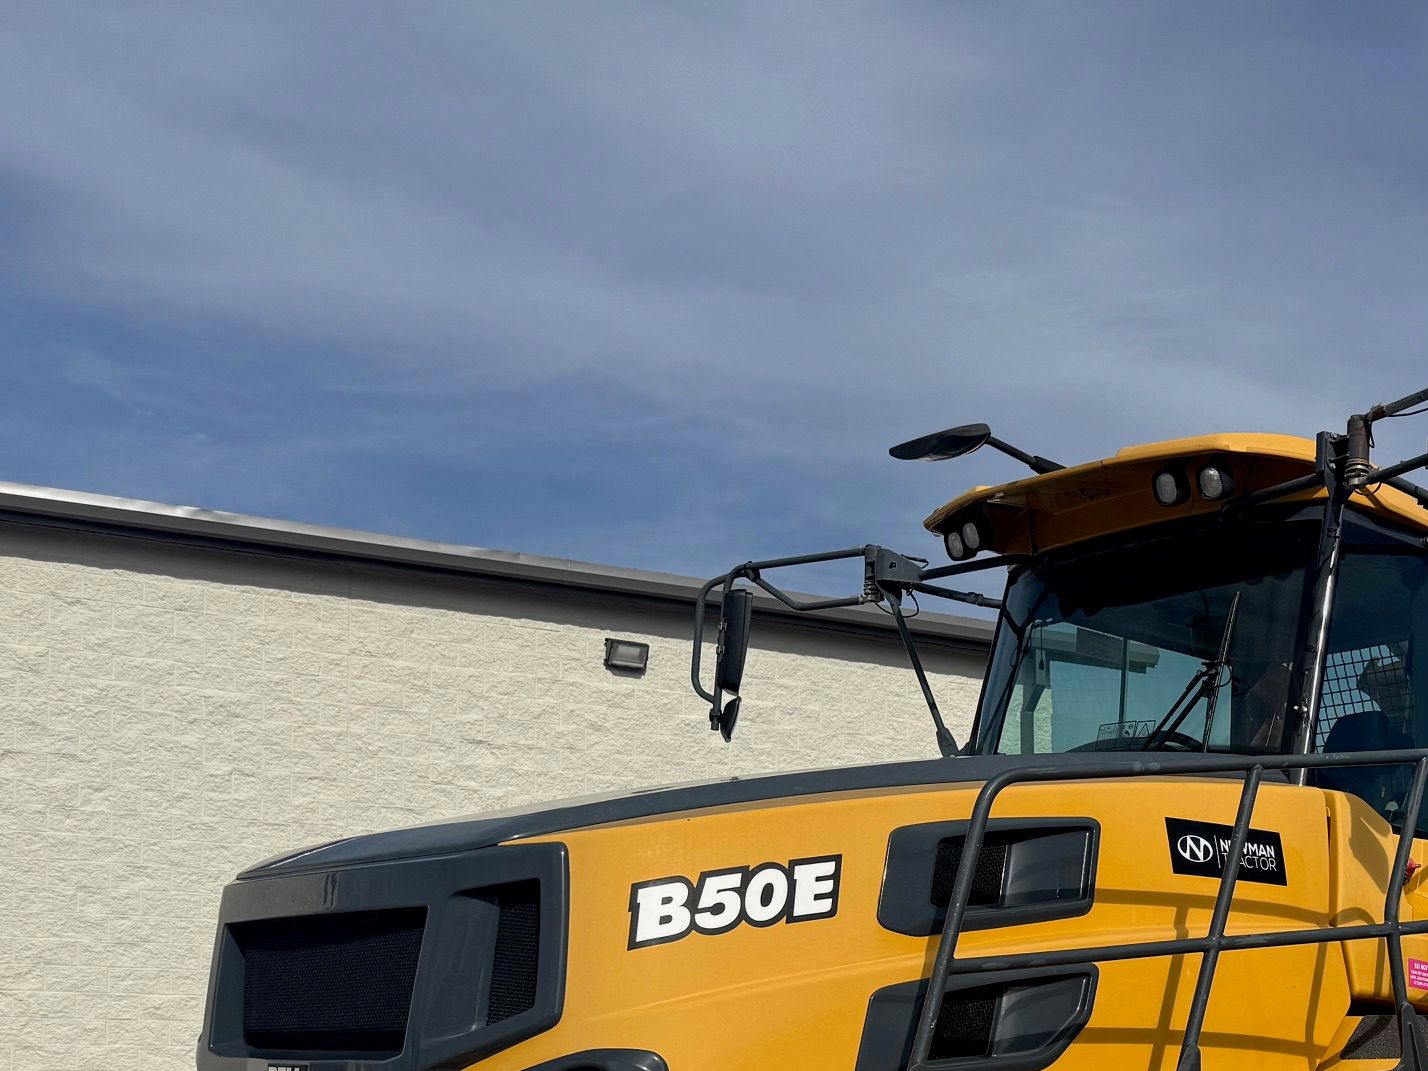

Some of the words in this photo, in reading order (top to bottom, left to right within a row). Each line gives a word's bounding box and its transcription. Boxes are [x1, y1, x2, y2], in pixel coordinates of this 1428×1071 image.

[1219, 838, 1275, 858] NMAN
[1221, 852, 1277, 871] TACTOR
[630, 857, 839, 946] B50E
